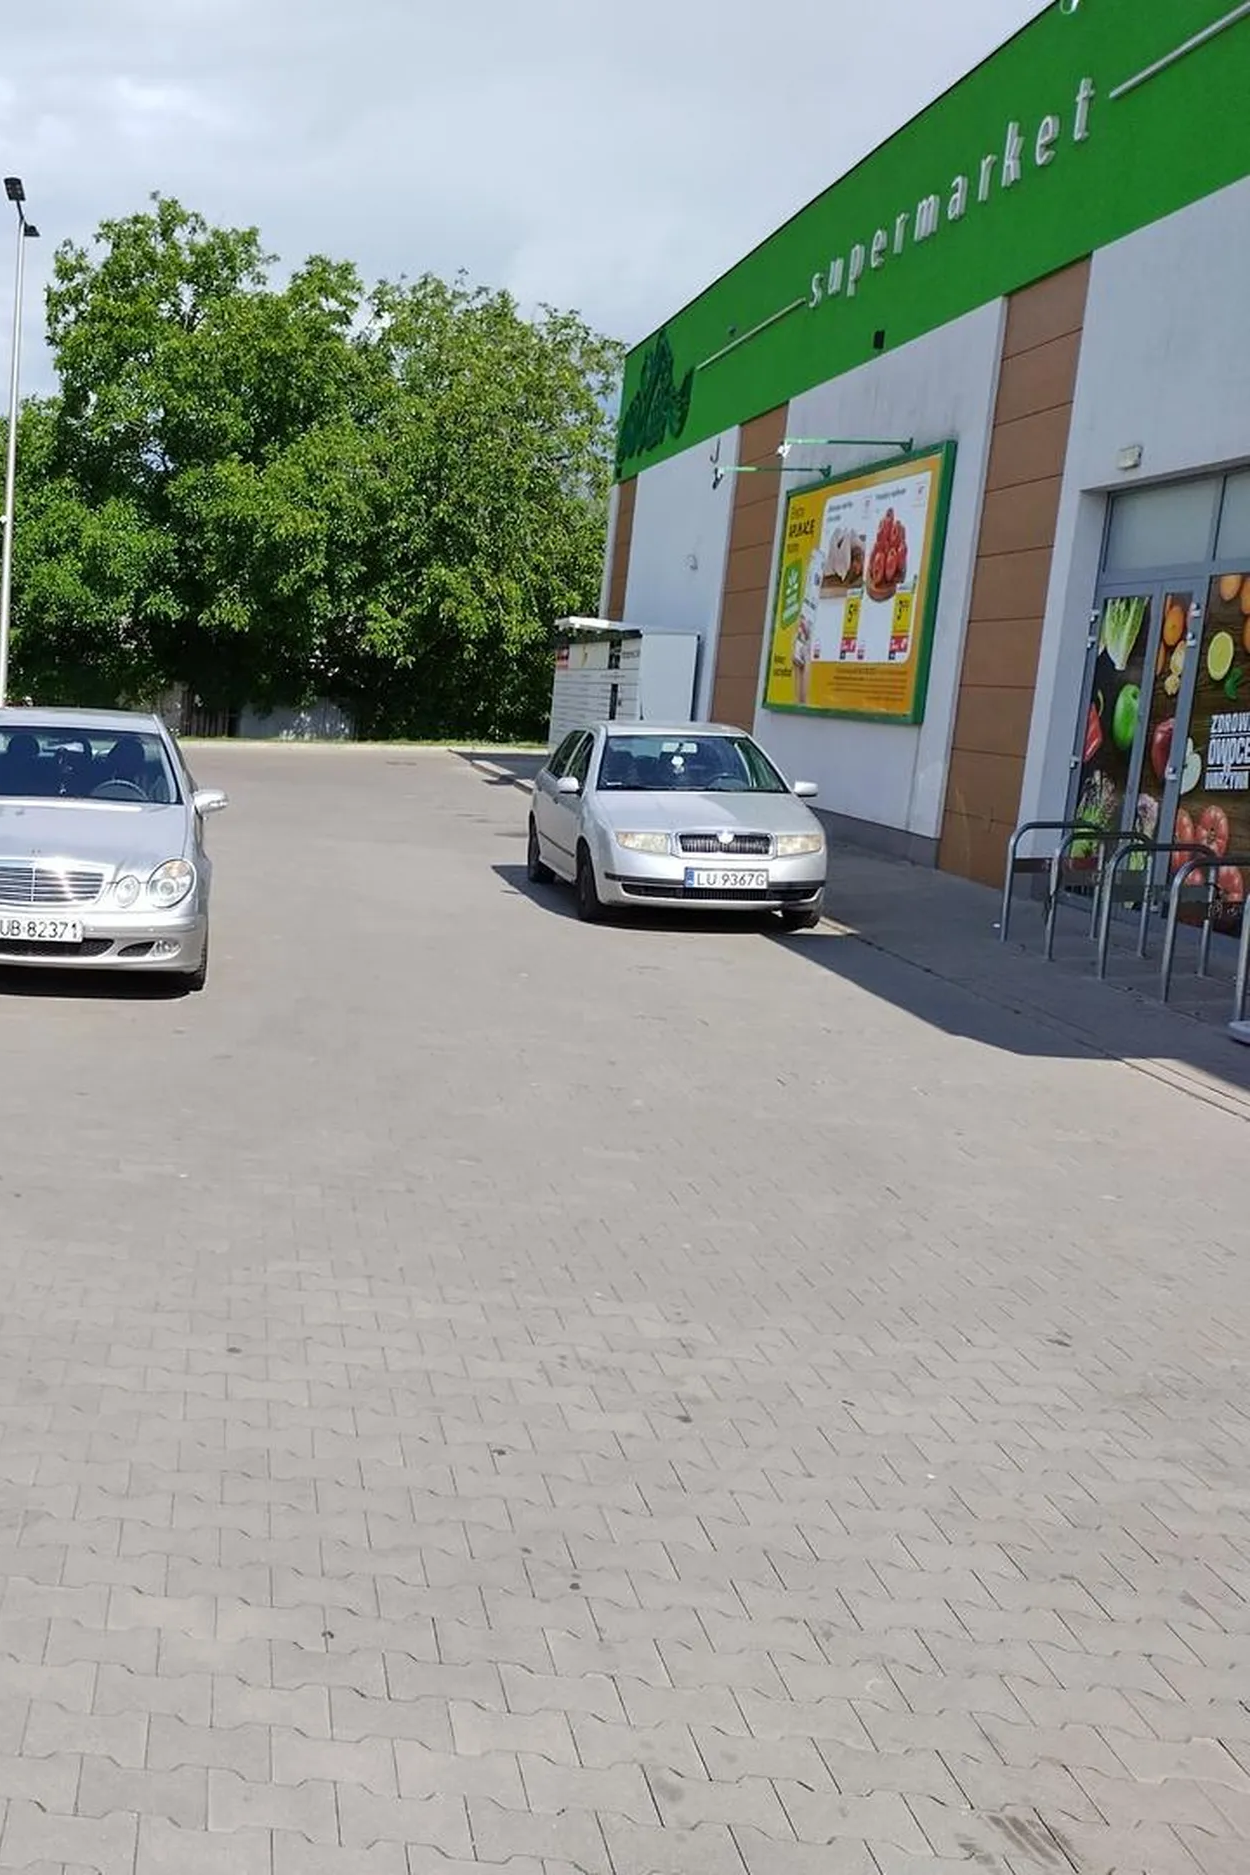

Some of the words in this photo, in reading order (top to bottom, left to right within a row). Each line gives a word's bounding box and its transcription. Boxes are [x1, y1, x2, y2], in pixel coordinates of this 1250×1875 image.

[808, 77, 1095, 307] supermarket
[697, 873, 717, 886] LU
[721, 873, 765, 886] 9367G
[27, 921, 78, 939] 82371
